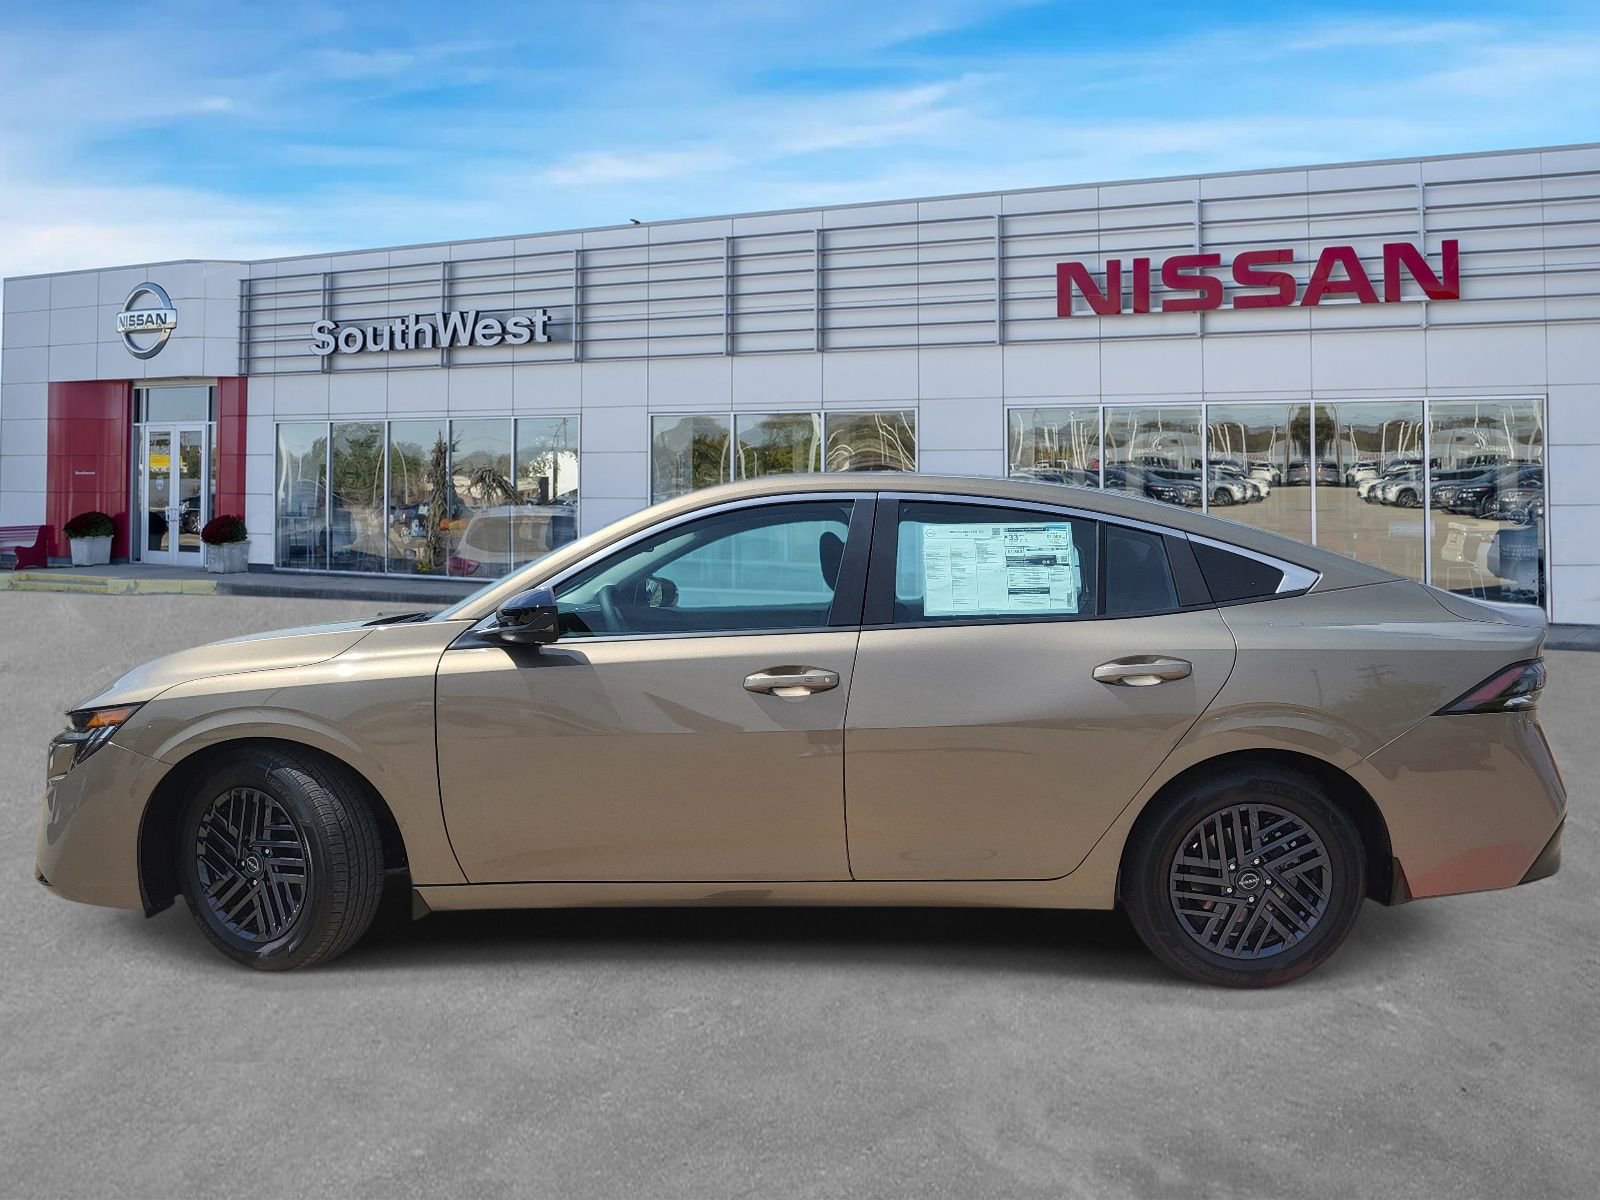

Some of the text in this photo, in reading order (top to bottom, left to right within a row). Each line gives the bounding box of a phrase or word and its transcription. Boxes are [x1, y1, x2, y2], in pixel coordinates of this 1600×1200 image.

[1056, 239, 1460, 317] NISSAN
[119, 312, 167, 328] NISSAN
[308, 308, 551, 356] SouthWest
